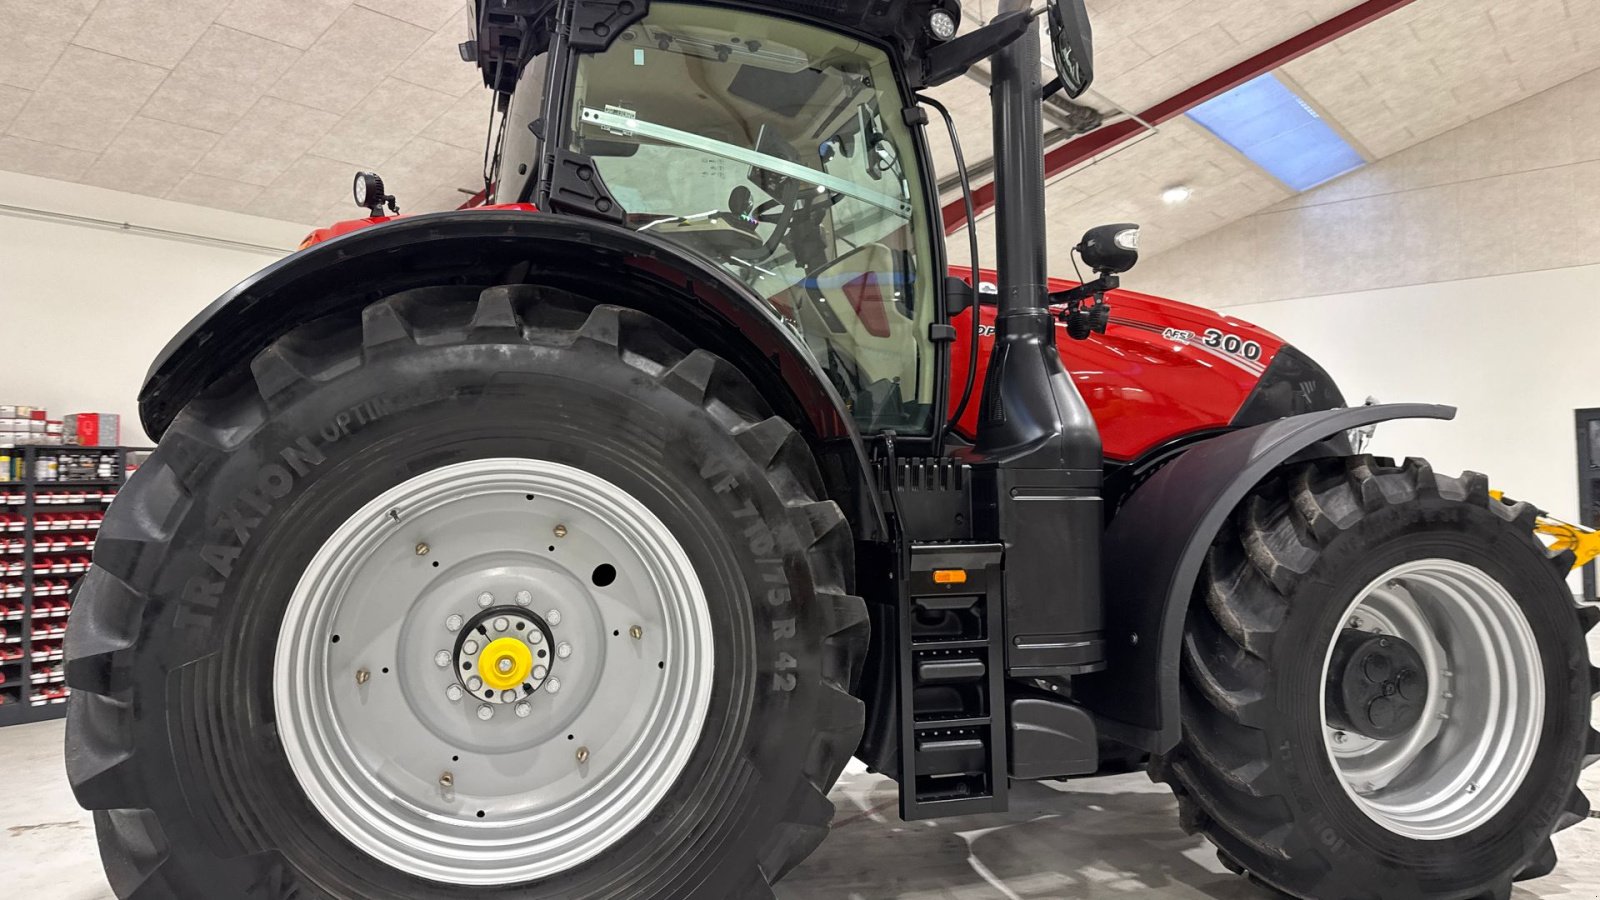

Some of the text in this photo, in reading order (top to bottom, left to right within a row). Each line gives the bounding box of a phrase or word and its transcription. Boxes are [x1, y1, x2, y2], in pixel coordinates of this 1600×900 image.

[1204, 329, 1261, 361] 300
[700, 452, 740, 495] VF
[173, 436, 328, 629] TRAXION
[772, 617, 796, 641] R
[772, 652, 798, 692] 42
